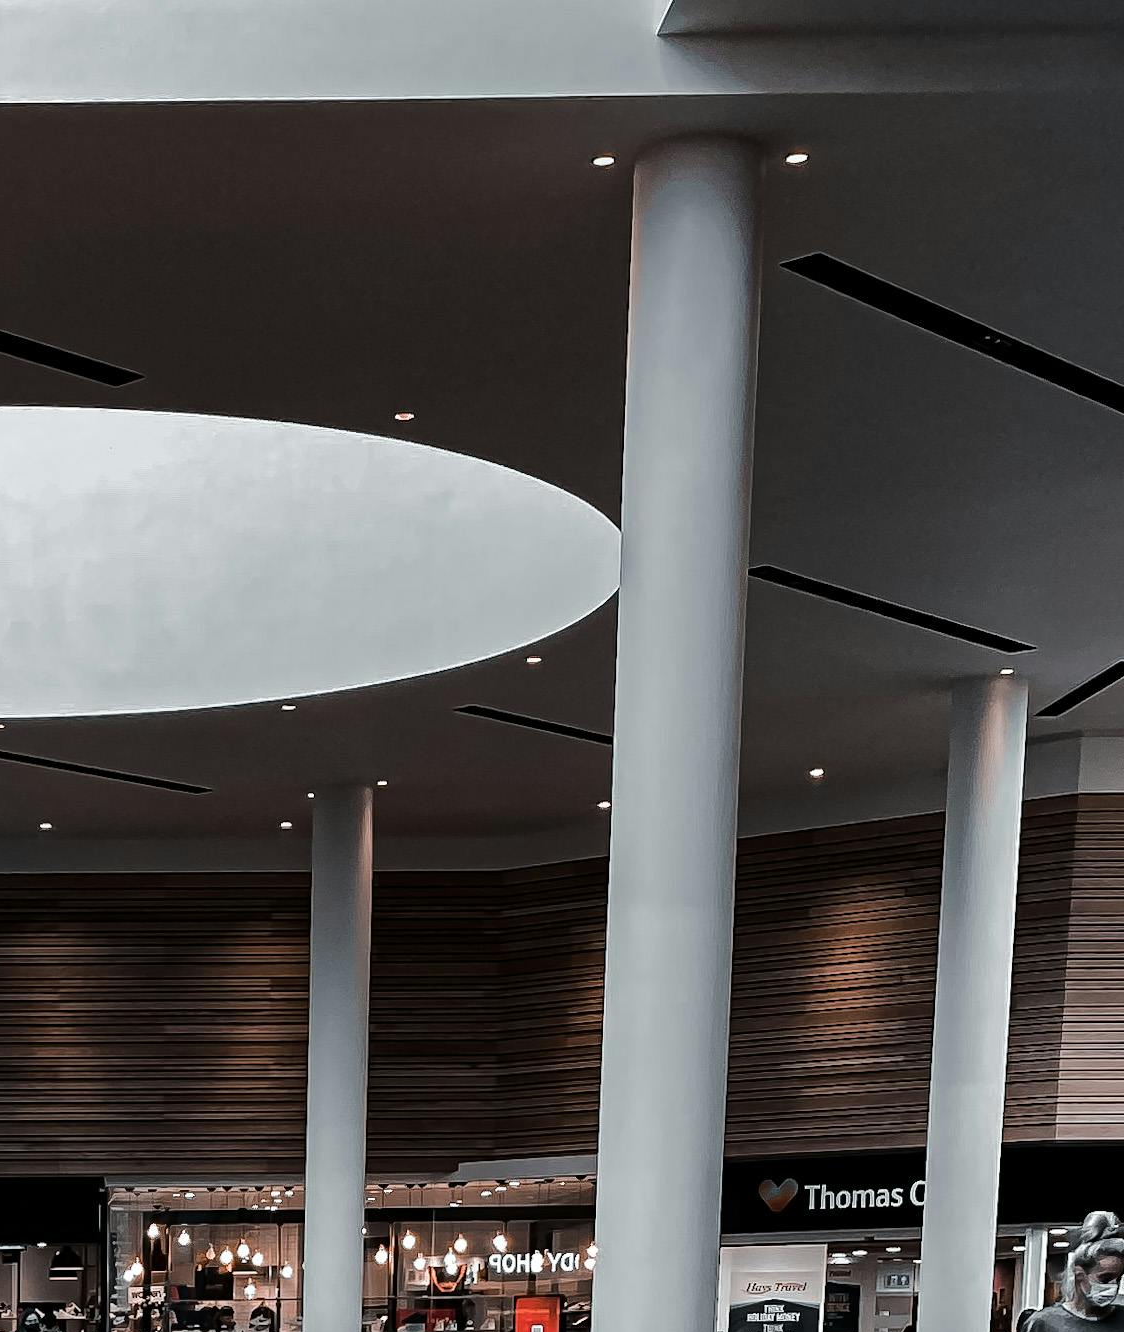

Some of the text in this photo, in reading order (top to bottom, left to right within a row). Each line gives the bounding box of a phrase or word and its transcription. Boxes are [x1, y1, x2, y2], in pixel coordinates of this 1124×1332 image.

[804, 1183, 904, 1210] Thomas
[746, 1282, 807, 1292] Hays Travel
